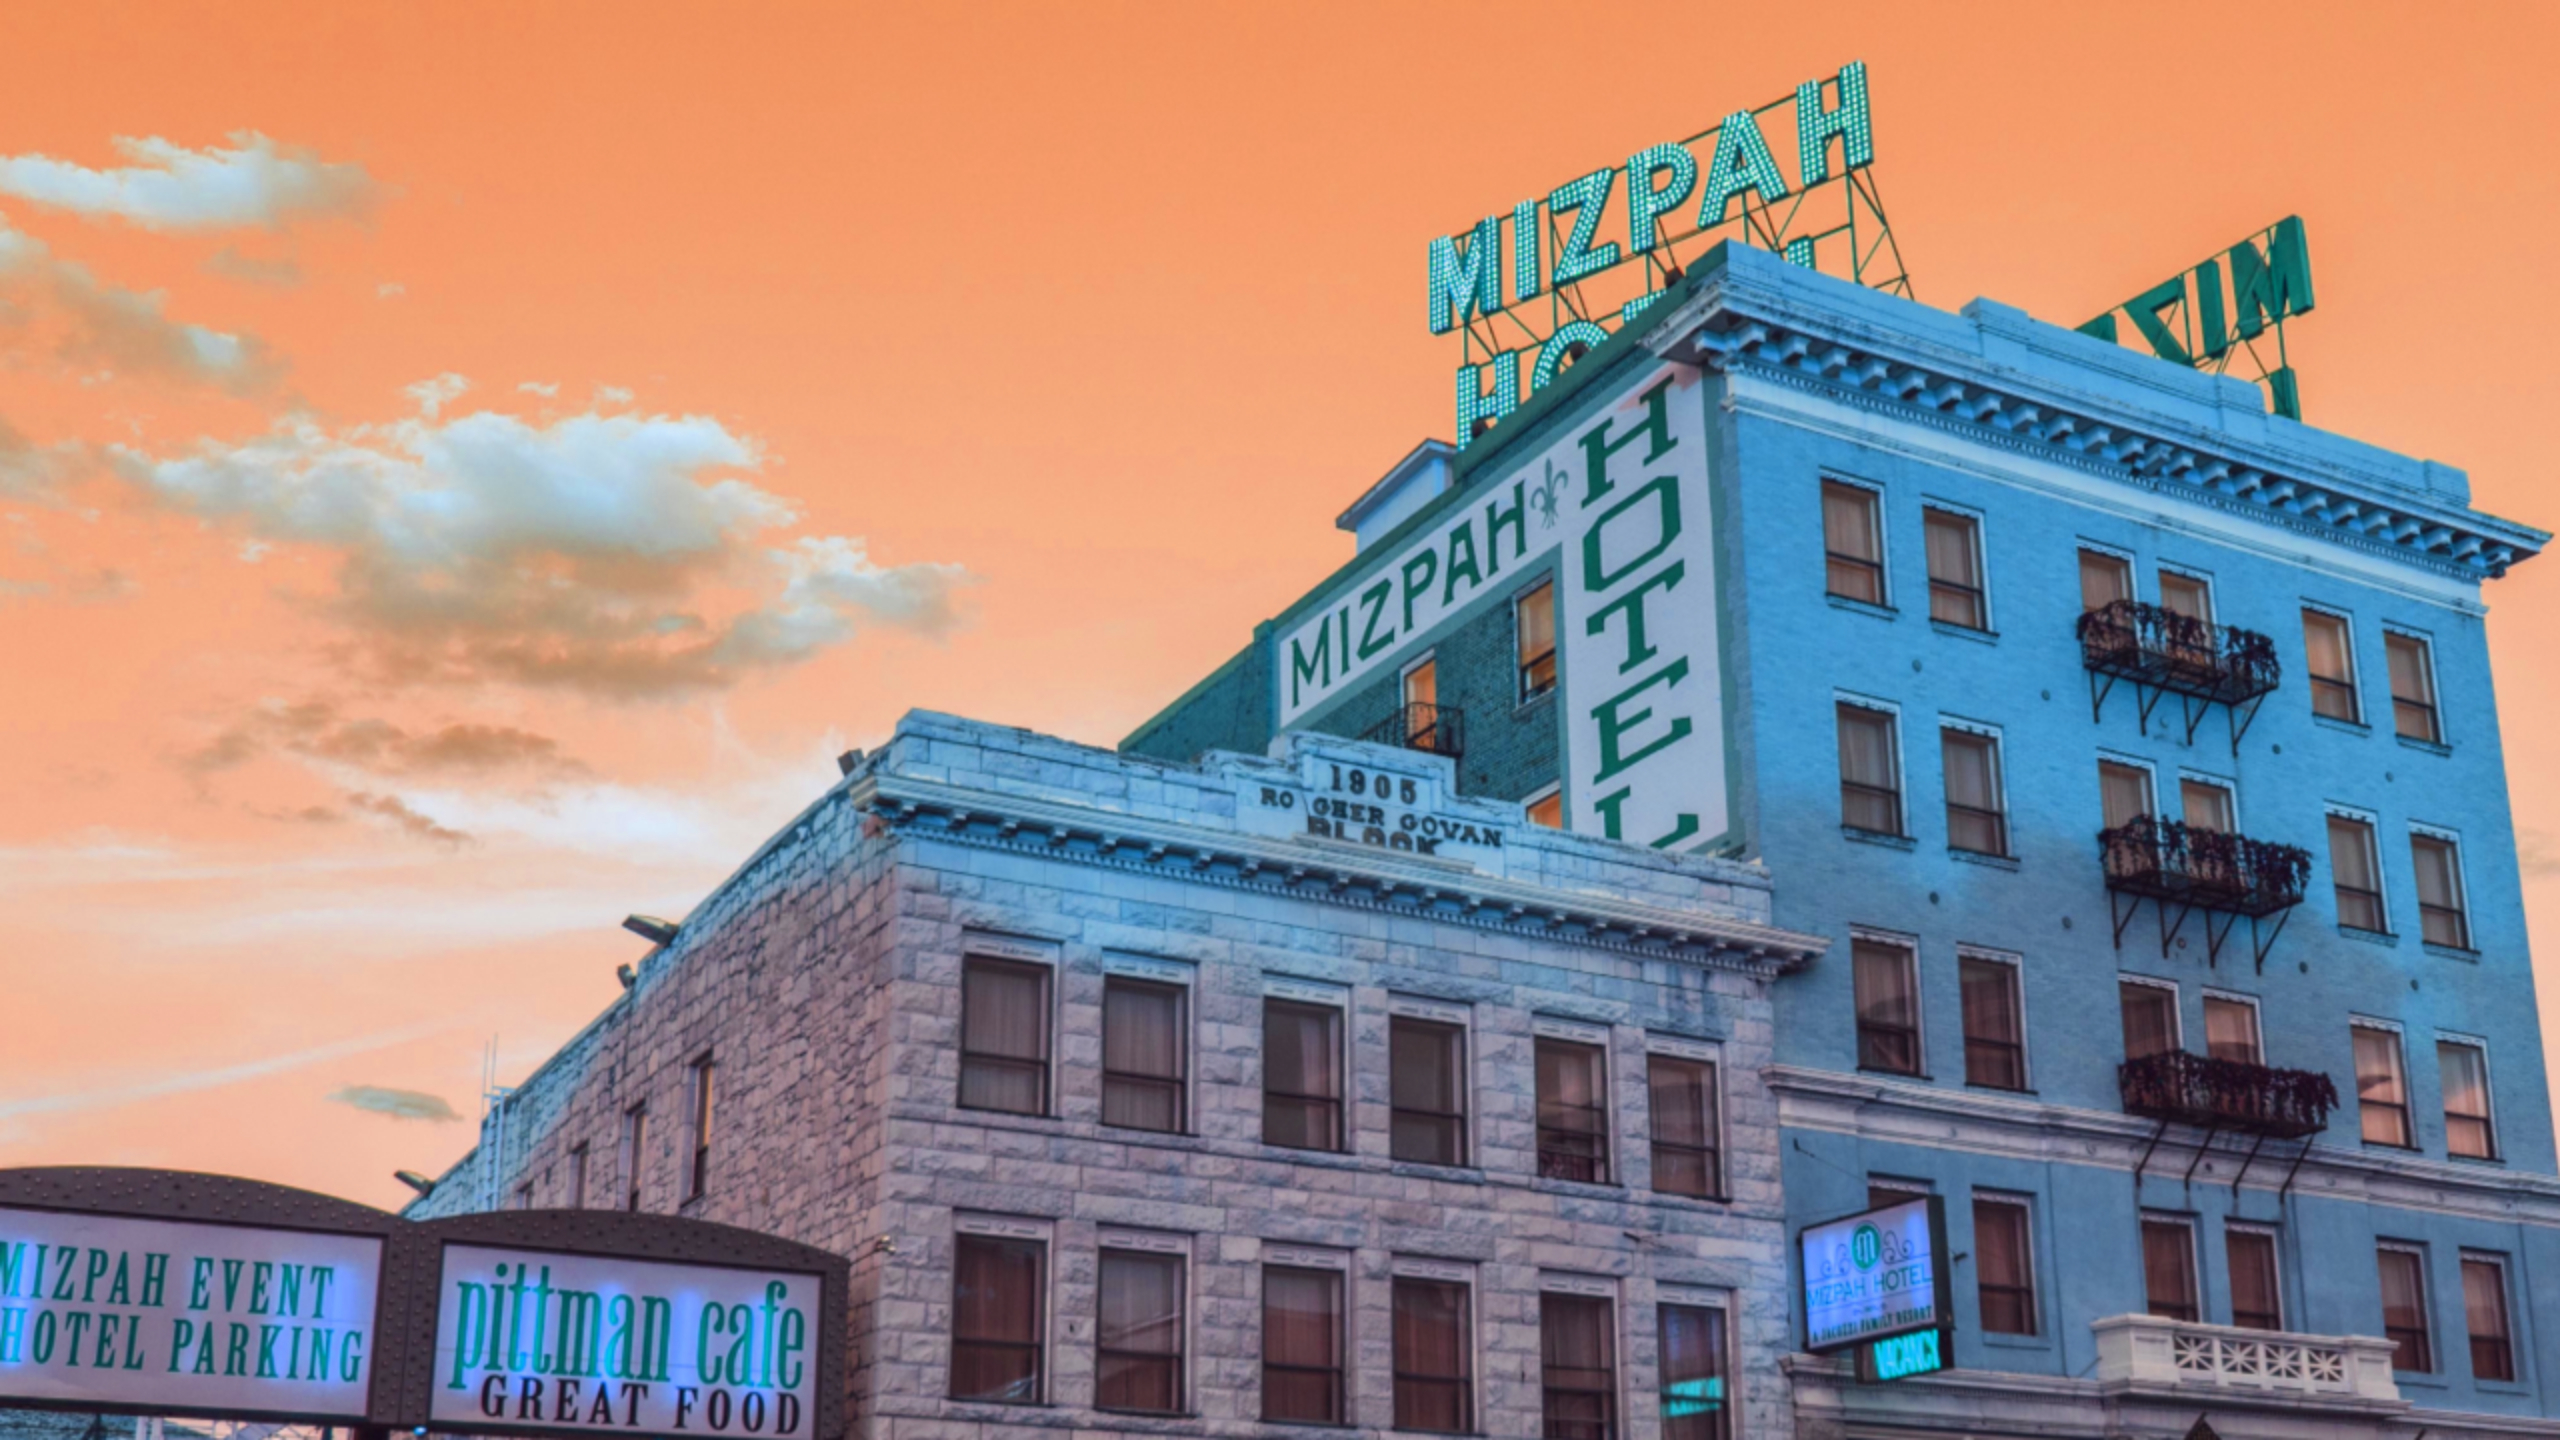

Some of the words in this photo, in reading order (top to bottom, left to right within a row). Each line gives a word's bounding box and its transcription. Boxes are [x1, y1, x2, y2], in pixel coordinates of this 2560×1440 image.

[1429, 60, 1873, 336] MIZPAH
[1291, 478, 1527, 709] MIZPAH
[1578, 374, 1699, 850] HOTEL
[1330, 764, 1417, 805] 1905
[1400, 814, 1502, 848] GOVAN
[0, 1241, 170, 1307] MIZPAH
[188, 1256, 334, 1319] EVENT
[1806, 1277, 1867, 1308] MIZPAH
[1873, 1263, 1934, 1292] HOTEL
[0, 1307, 145, 1371] HOTEL
[167, 1318, 363, 1382] PARKING
[447, 1262, 671, 1390] pittman
[697, 1280, 805, 1390] cafe
[1873, 1328, 1942, 1380] VACANCY
[481, 1375, 648, 1426] GREAT
[672, 1387, 801, 1435] FOOD
